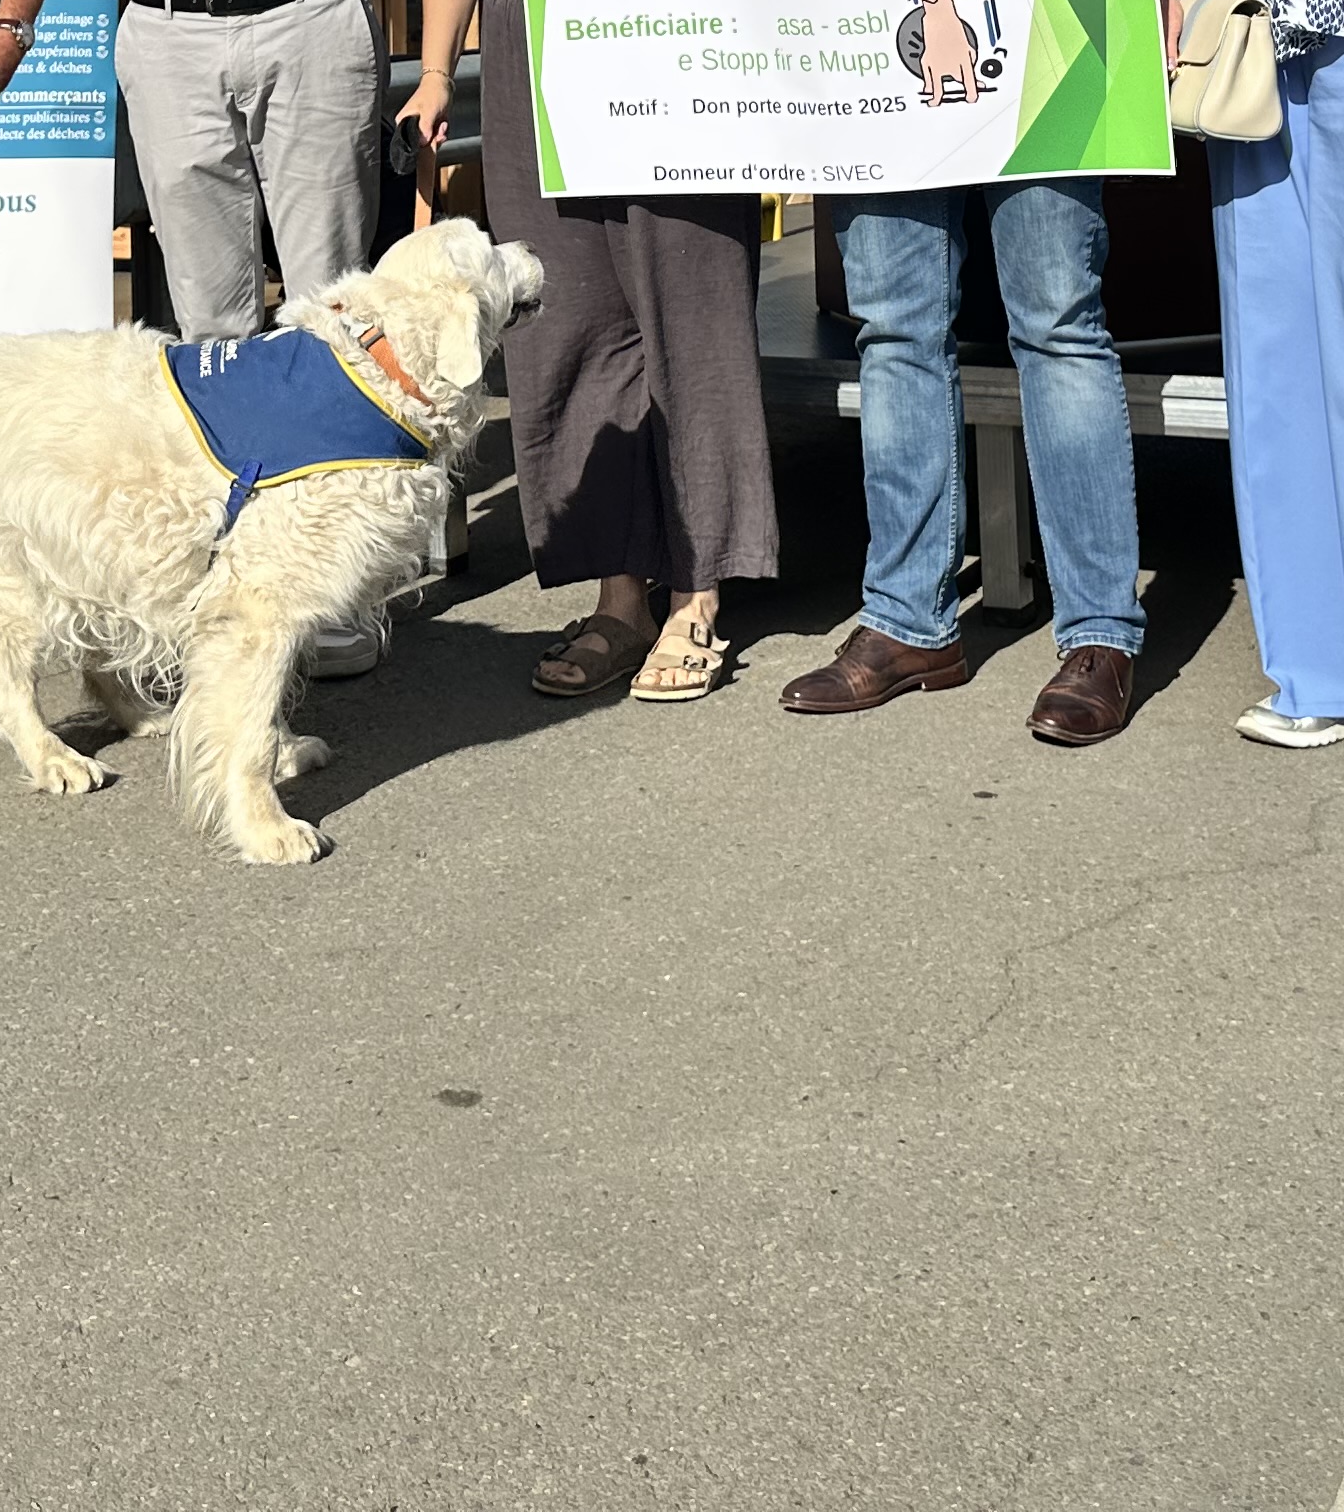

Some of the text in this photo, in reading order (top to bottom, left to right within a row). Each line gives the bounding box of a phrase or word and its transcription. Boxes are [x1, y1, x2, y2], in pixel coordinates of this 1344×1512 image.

[40, 12, 94, 28] jardinage
[565, 13, 723, 41] Bénéficiaire
[731, 17, 738, 34] :
[776, 17, 815, 36] asa
[837, 9, 890, 35] asbl
[59, 29, 93, 41] divers
[35, 63, 46, 74] &
[49, 61, 92, 74] déchets
[678, 47, 890, 77] e Stopp fir e Mupp
[2, 89, 106, 105] commerçants
[609, 99, 658, 117] Motif
[692, 98, 731, 114] Don
[737, 98, 782, 118] porte
[787, 100, 853, 116] ouverte
[858, 95, 907, 115] 2025
[23, 110, 90, 126] publicitaires
[27, 128, 45, 140] des
[47, 127, 90, 140] déchets
[654, 166, 735, 182] Donneur
[742, 164, 805, 182] d'ordre
[823, 164, 885, 182] SIVEC
